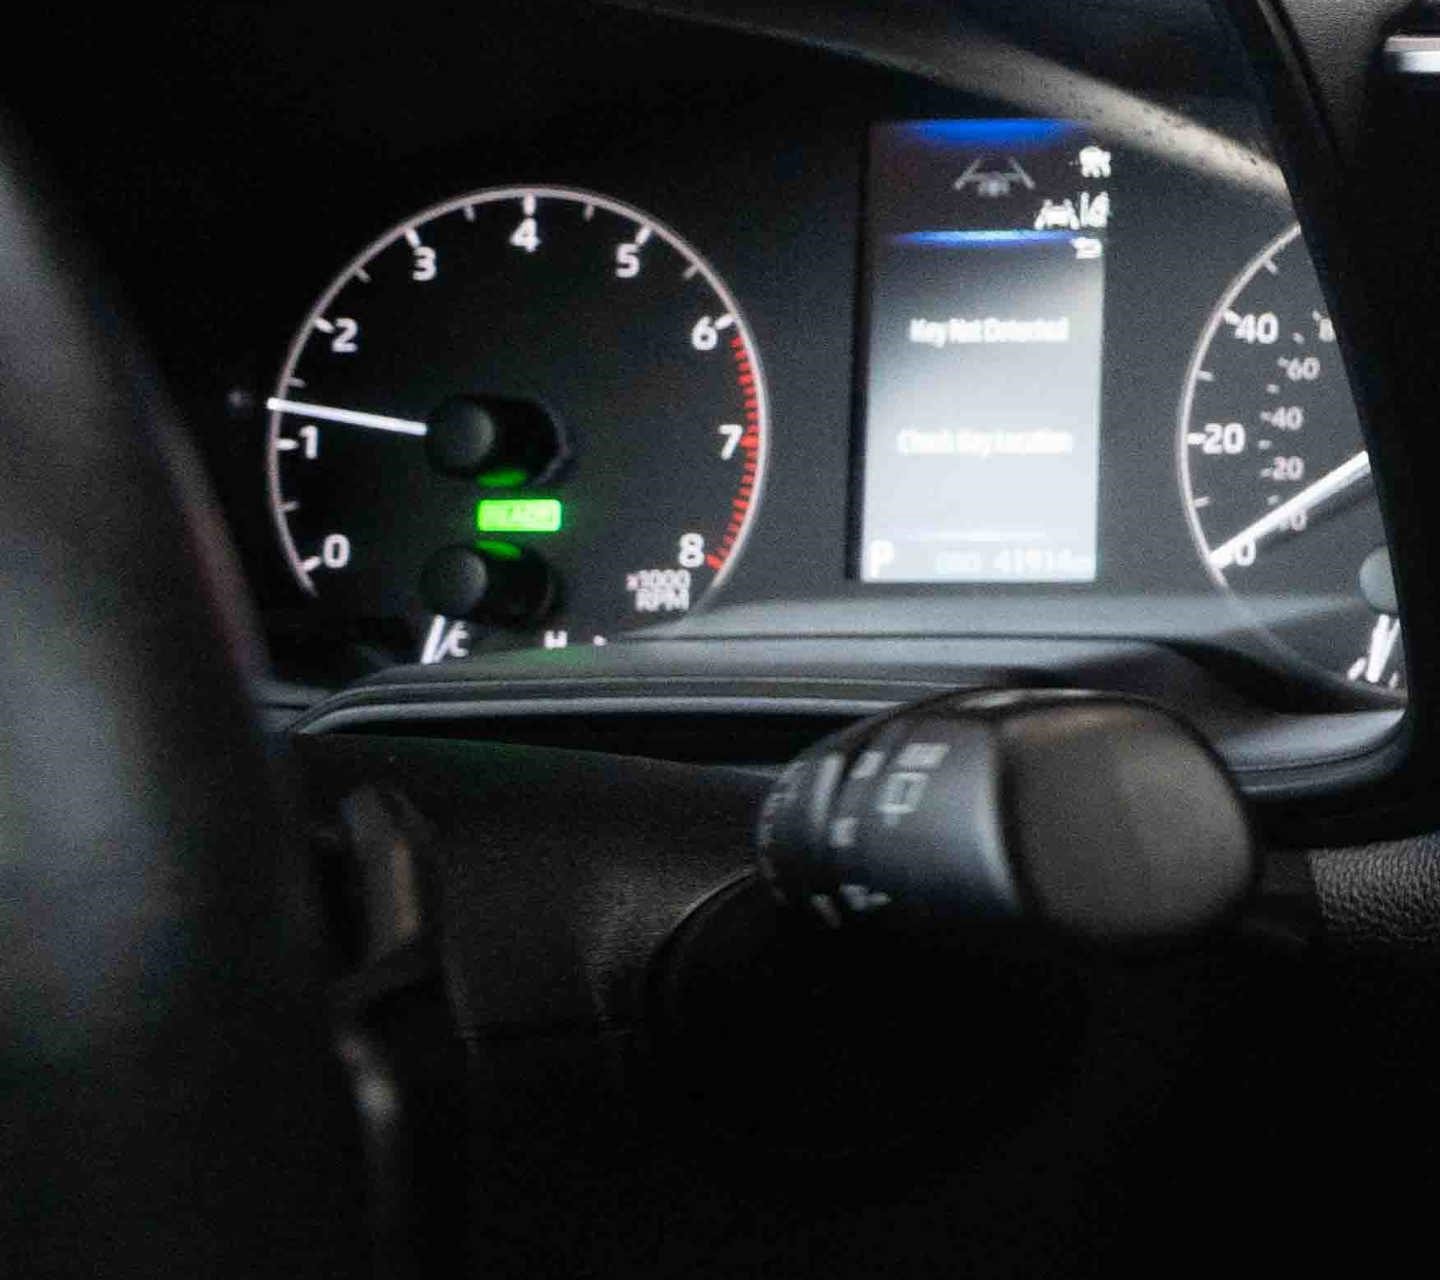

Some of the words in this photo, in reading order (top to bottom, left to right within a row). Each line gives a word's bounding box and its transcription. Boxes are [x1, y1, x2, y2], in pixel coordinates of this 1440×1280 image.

[509, 218, 541, 253] 4
[412, 246, 438, 282] 3
[614, 242, 641, 278] 5
[331, 317, 358, 353] 2
[690, 315, 718, 352] 6
[1235, 313, 1280, 345] 40
[1284, 356, 1321, 381] 60
[1269, 406, 1304, 431] 40
[300, 425, 319, 460] 1
[717, 424, 743, 461] 7
[1201, 423, 1247, 455] 20
[1271, 455, 1305, 480] 20
[323, 533, 351, 569] 0
[679, 533, 705, 569] 8
[868, 540, 896, 578] P
